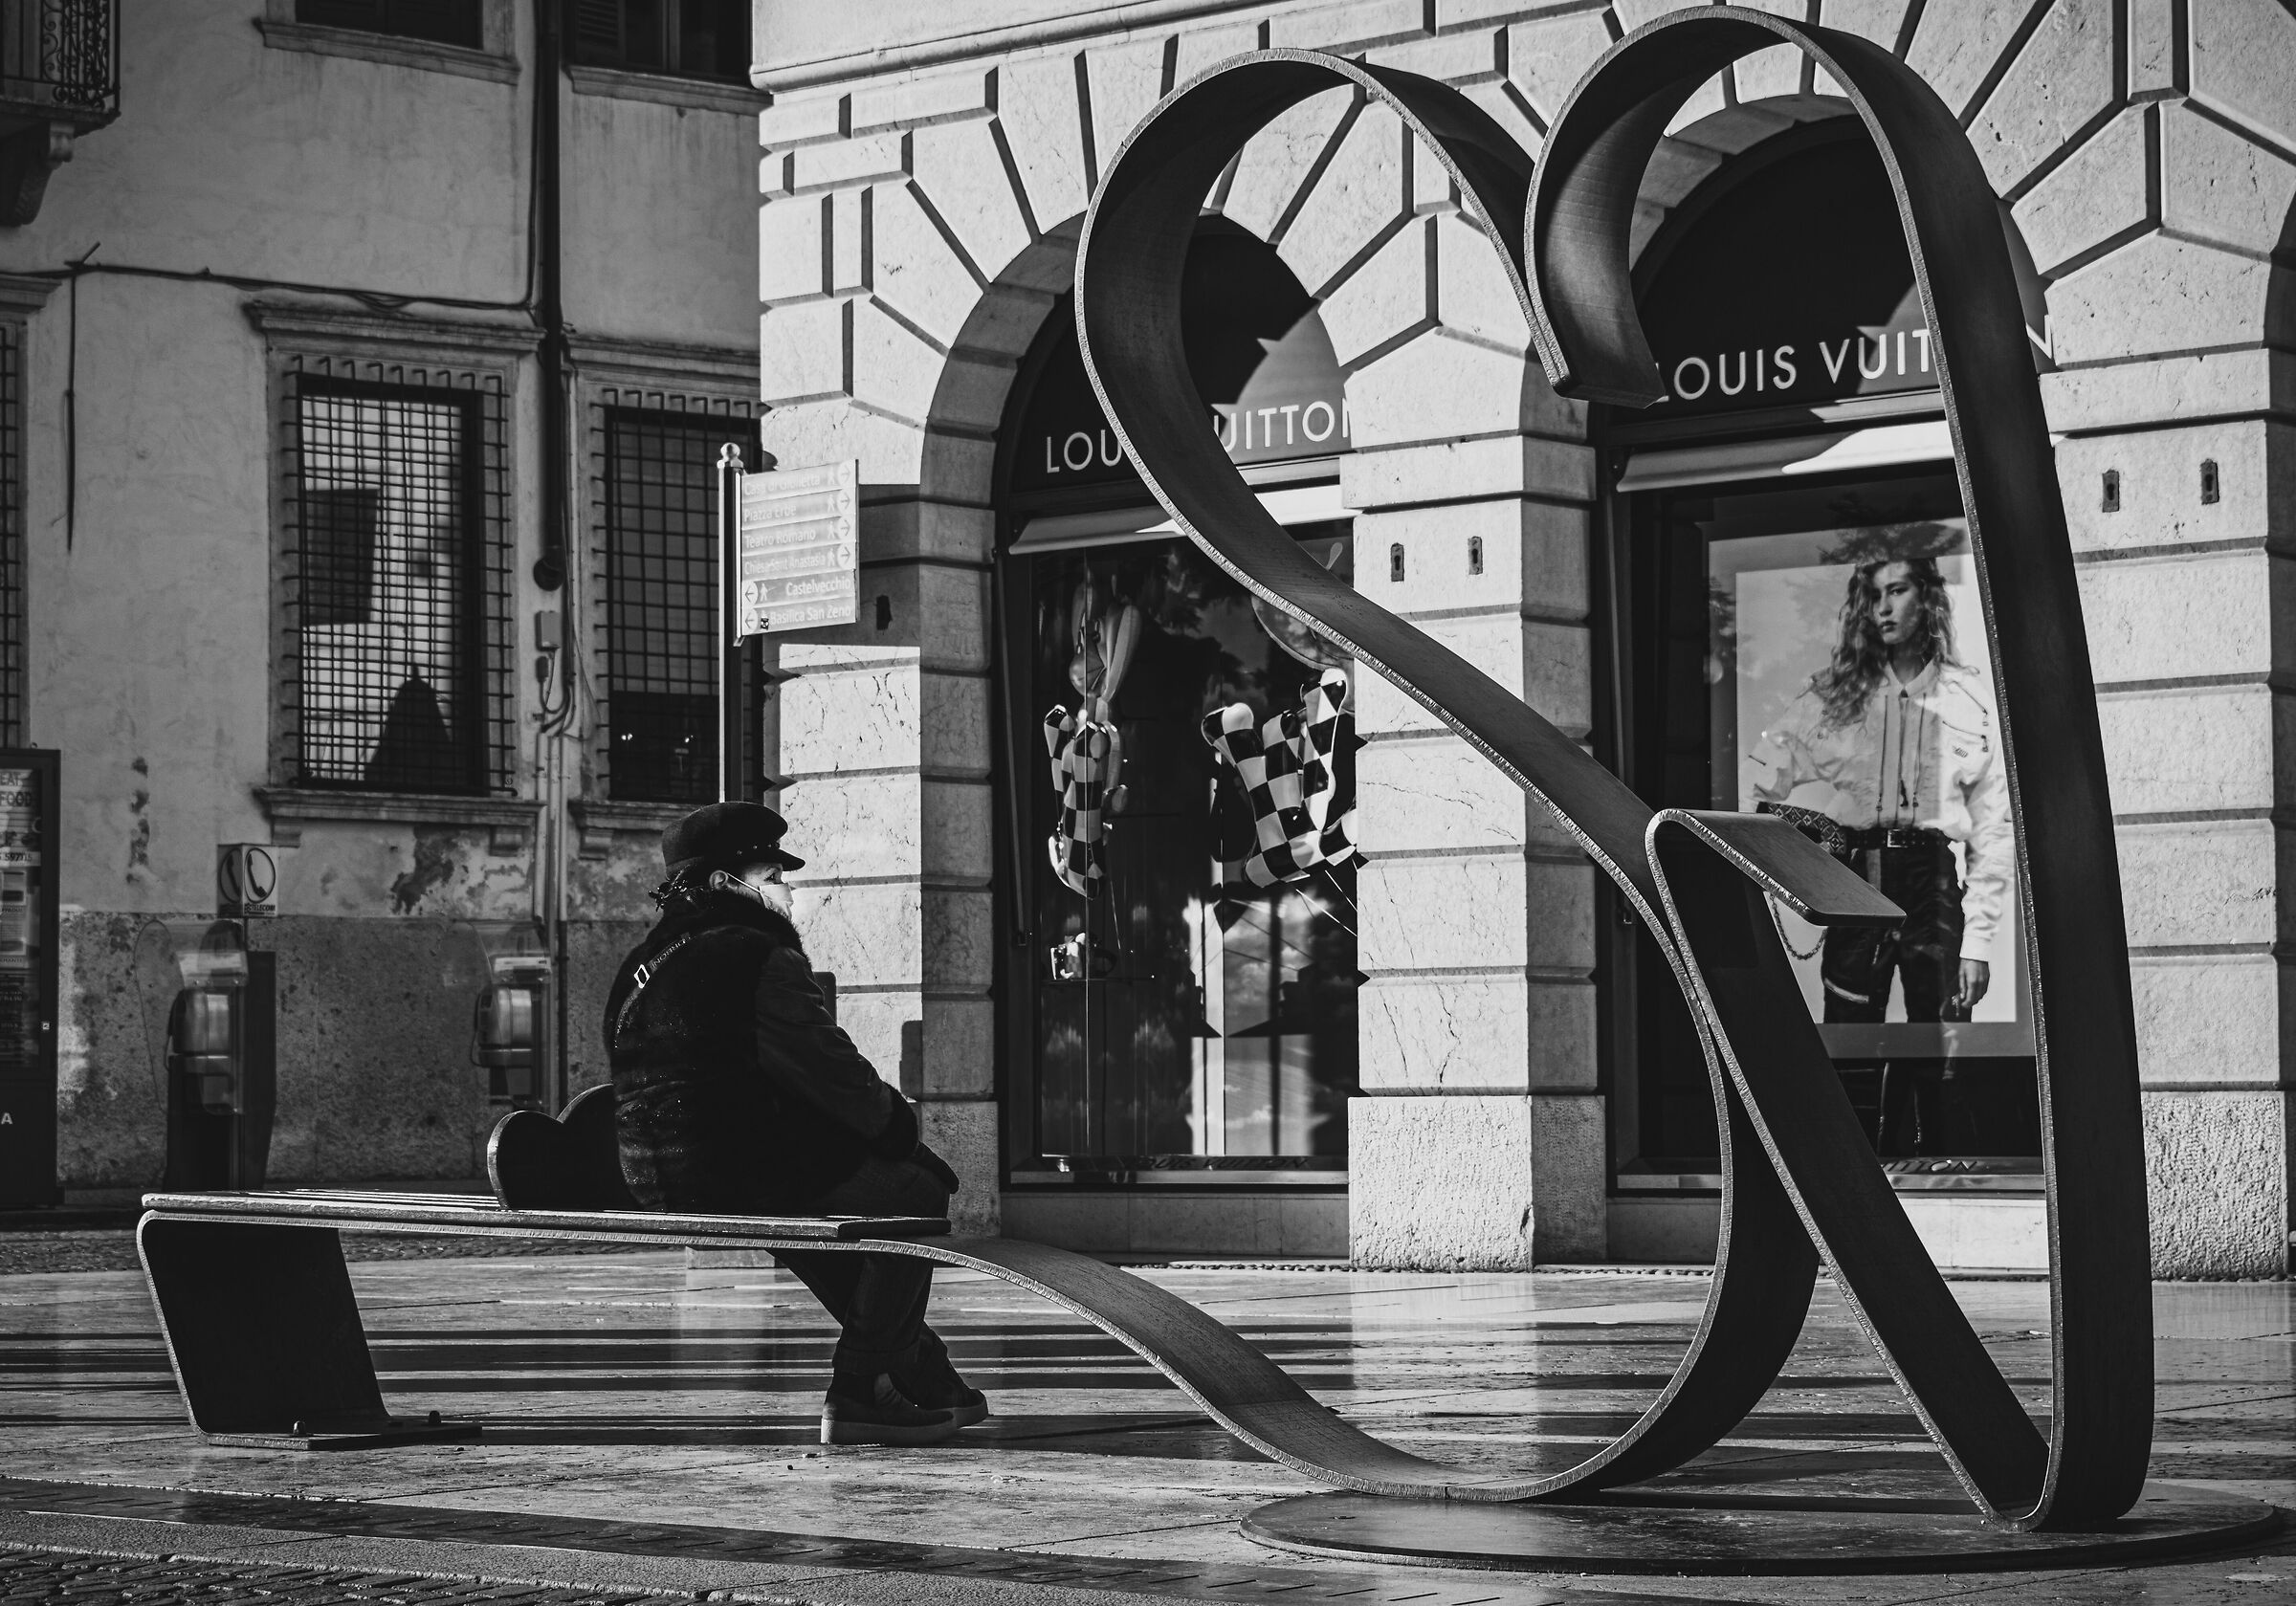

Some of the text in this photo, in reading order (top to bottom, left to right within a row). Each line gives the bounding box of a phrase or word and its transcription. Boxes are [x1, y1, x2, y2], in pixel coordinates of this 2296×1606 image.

[1656, 315, 2053, 403] OUIS VUITN
[1047, 398, 1351, 474] LOU UITTO
[744, 482, 766, 496] Casa
[744, 504, 797, 522] Piazza Erbe
[745, 529, 816, 549] Teatro Romano
[785, 575, 851, 596] Castelvecchio
[769, 604, 851, 625] Basilica San Zeno
[1882, 1160, 1977, 1172] ITTON
